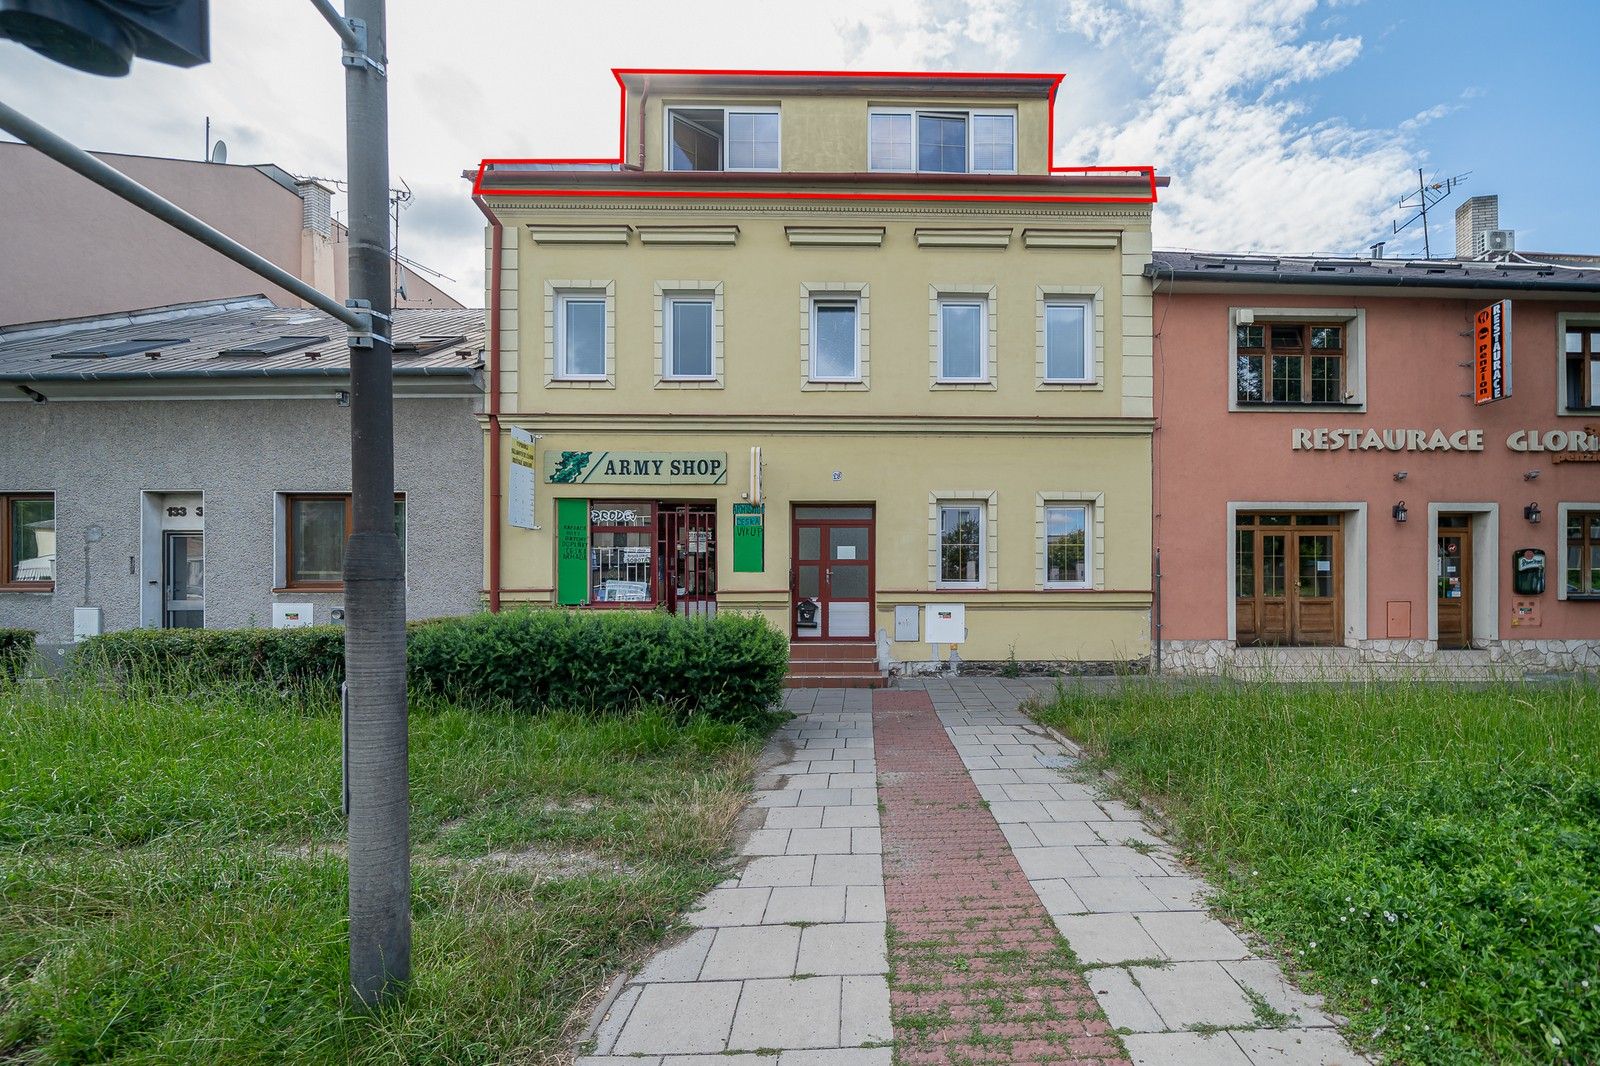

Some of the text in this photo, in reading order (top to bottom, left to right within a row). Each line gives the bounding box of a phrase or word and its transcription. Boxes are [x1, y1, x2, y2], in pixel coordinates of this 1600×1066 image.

[1492, 304, 1502, 399] RESTAURACE
[1479, 344, 1488, 395] penzion
[1292, 429, 1484, 451] RESTAURACE
[604, 459, 721, 475] ARMY SHOP
[166, 506, 187, 517] 133
